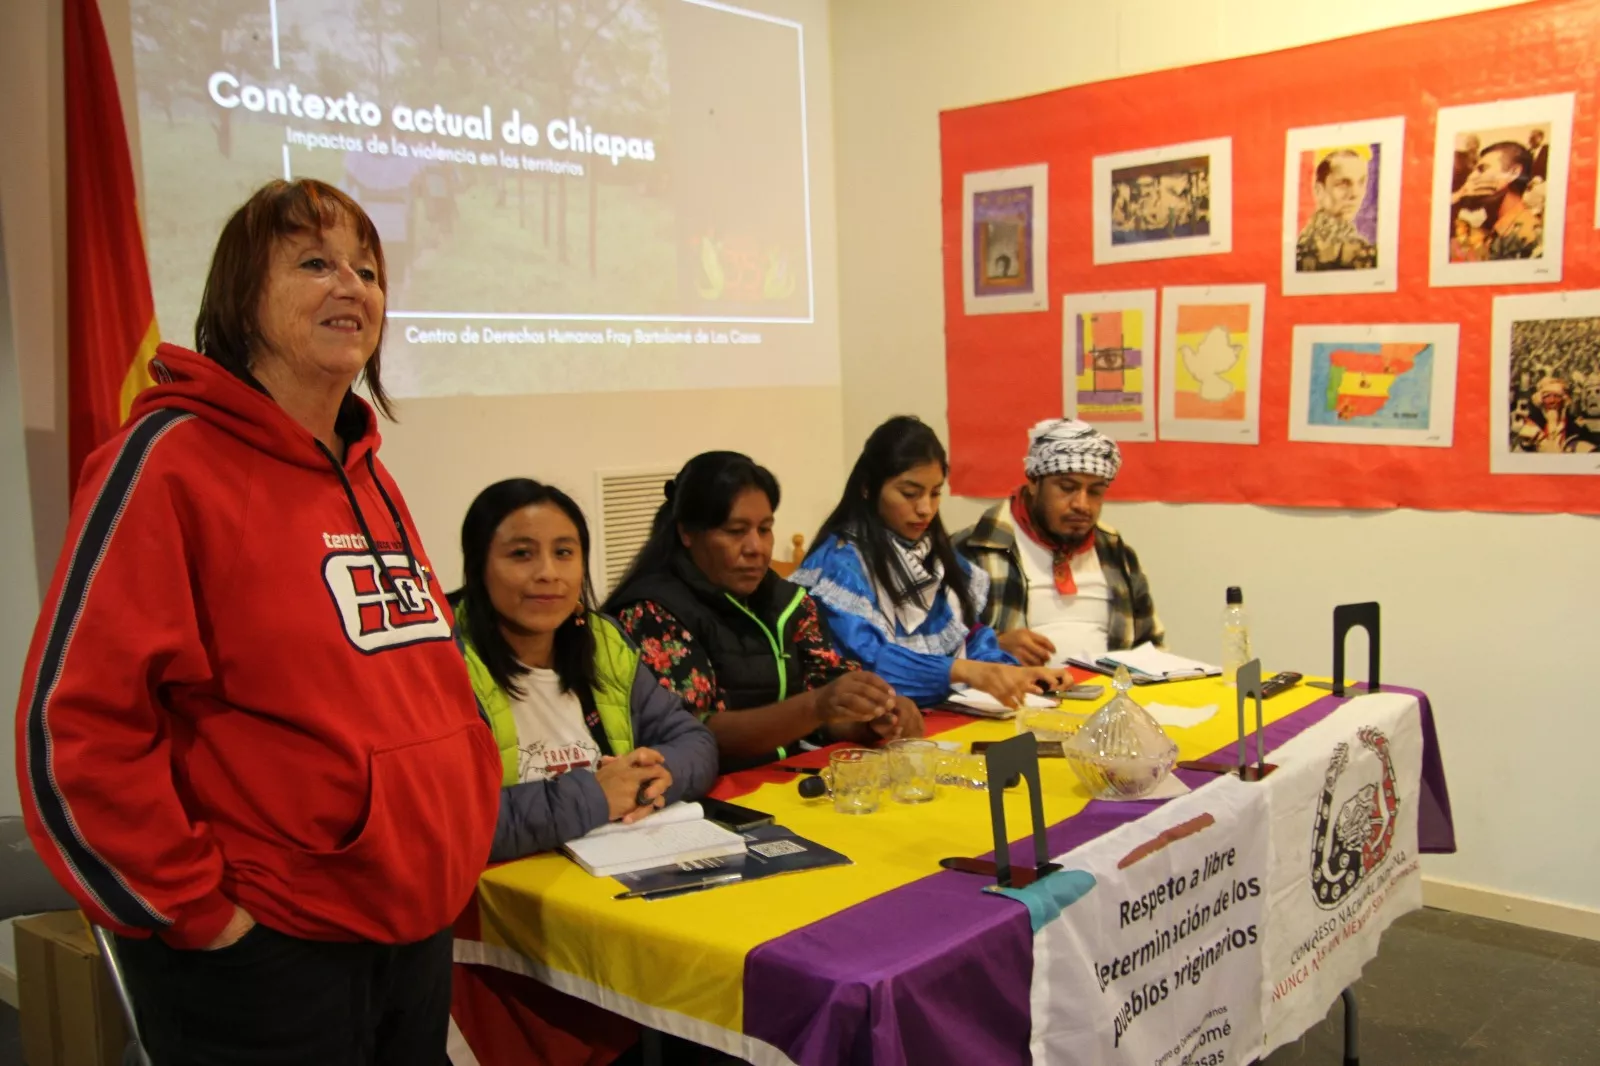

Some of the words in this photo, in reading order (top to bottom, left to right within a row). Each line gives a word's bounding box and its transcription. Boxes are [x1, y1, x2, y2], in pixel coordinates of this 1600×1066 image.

[208, 70, 382, 127] Contexto
[392, 103, 493, 141] actual
[502, 109, 539, 147] de
[546, 119, 655, 166] Chiapas
[286, 126, 363, 155] Impactos
[366, 132, 389, 156] de
[391, 135, 408, 158] la
[411, 142, 477, 166] violencia
[479, 150, 498, 167] en
[499, 150, 520, 170] los
[522, 154, 584, 177] territorios
[405, 325, 457, 344] Centro
[460, 325, 480, 344] de
[482, 325, 545, 344] Derechos
[548, 327, 604, 344] Humanos
[605, 328, 632, 348] Fray
[694, 328, 709, 344] de
[1119, 877, 1186, 929] Respeto
[1189, 871, 1200, 890] a
[1202, 847, 1236, 882] libre
[1213, 890, 1230, 918] de
[1231, 876, 1262, 905] los
[1113, 977, 1169, 1049] pueblos
